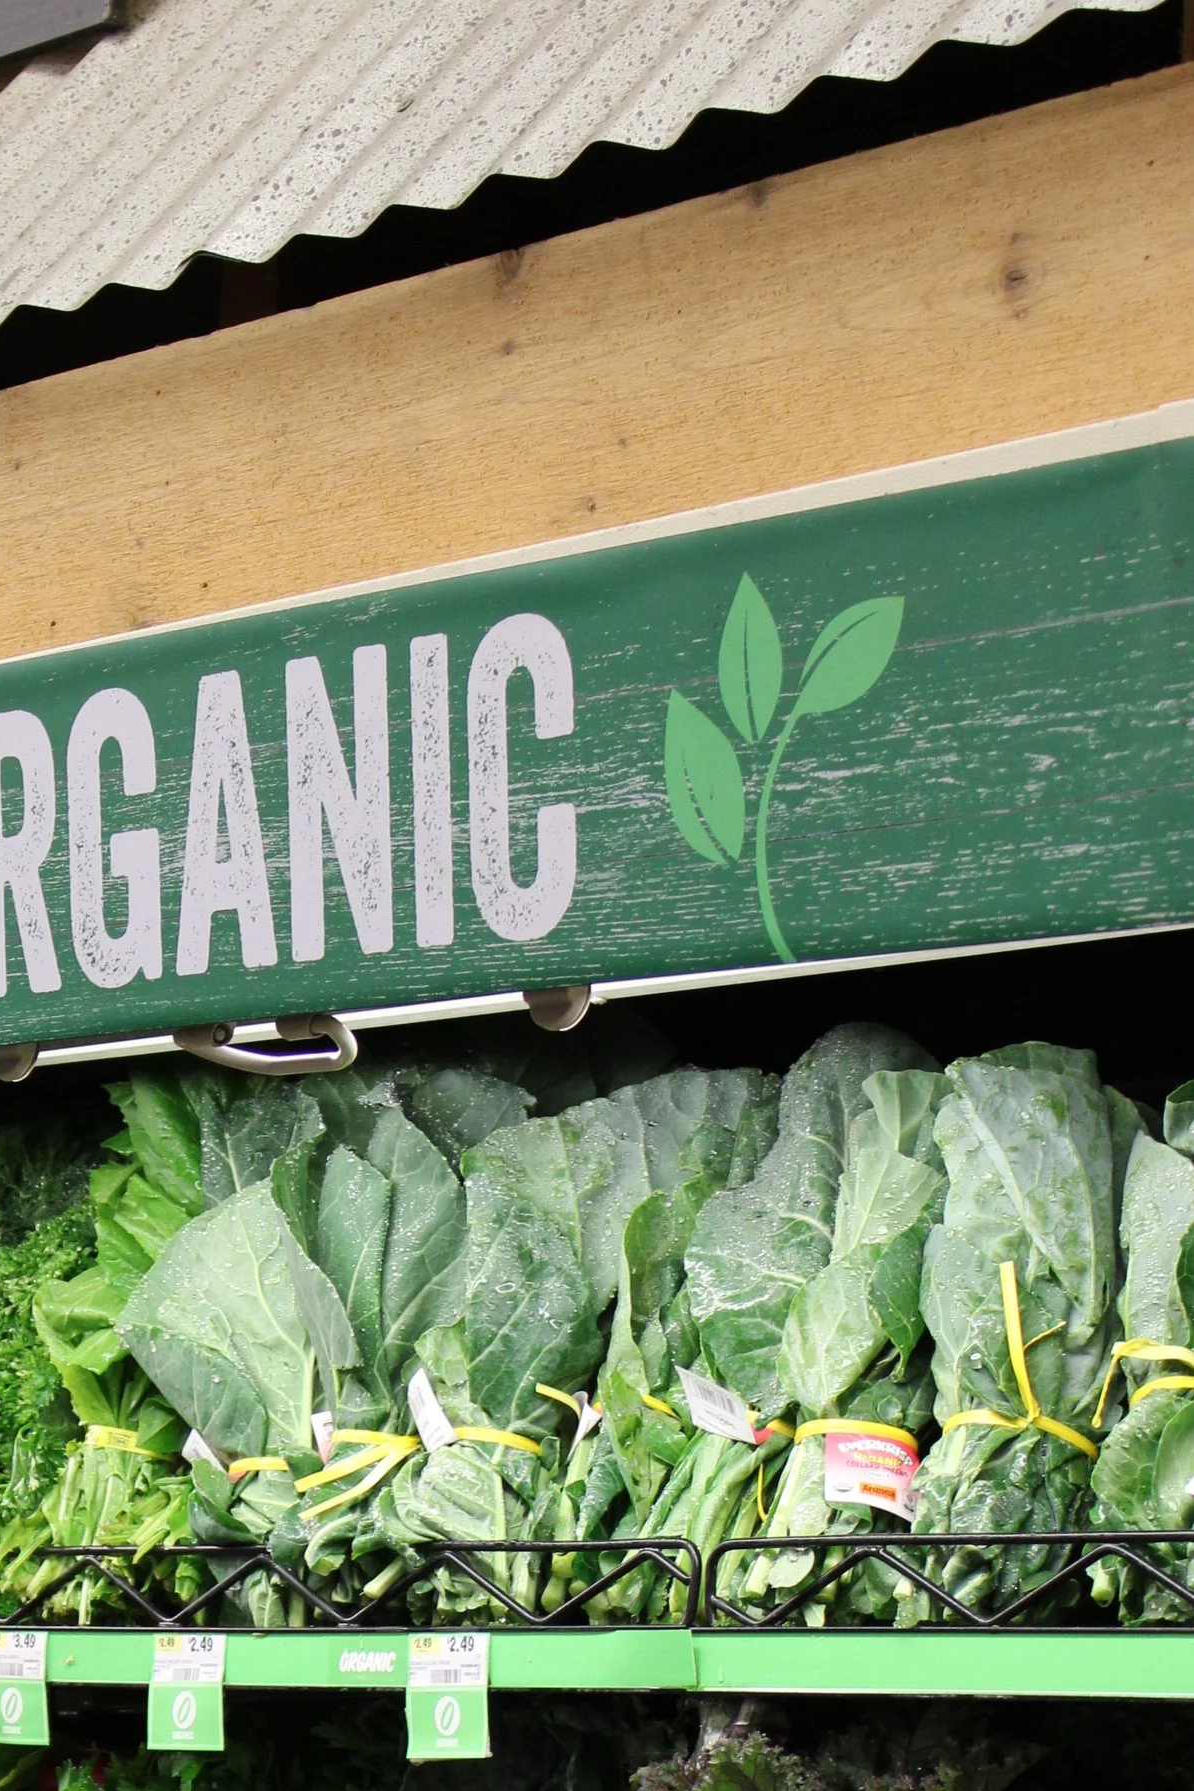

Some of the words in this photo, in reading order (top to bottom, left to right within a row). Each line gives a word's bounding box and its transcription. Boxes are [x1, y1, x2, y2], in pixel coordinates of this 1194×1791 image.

[862, 1484, 895, 1498] Arizona
[447, 1636, 475, 1652] $2.49
[339, 1651, 397, 1673] ORGANIC
